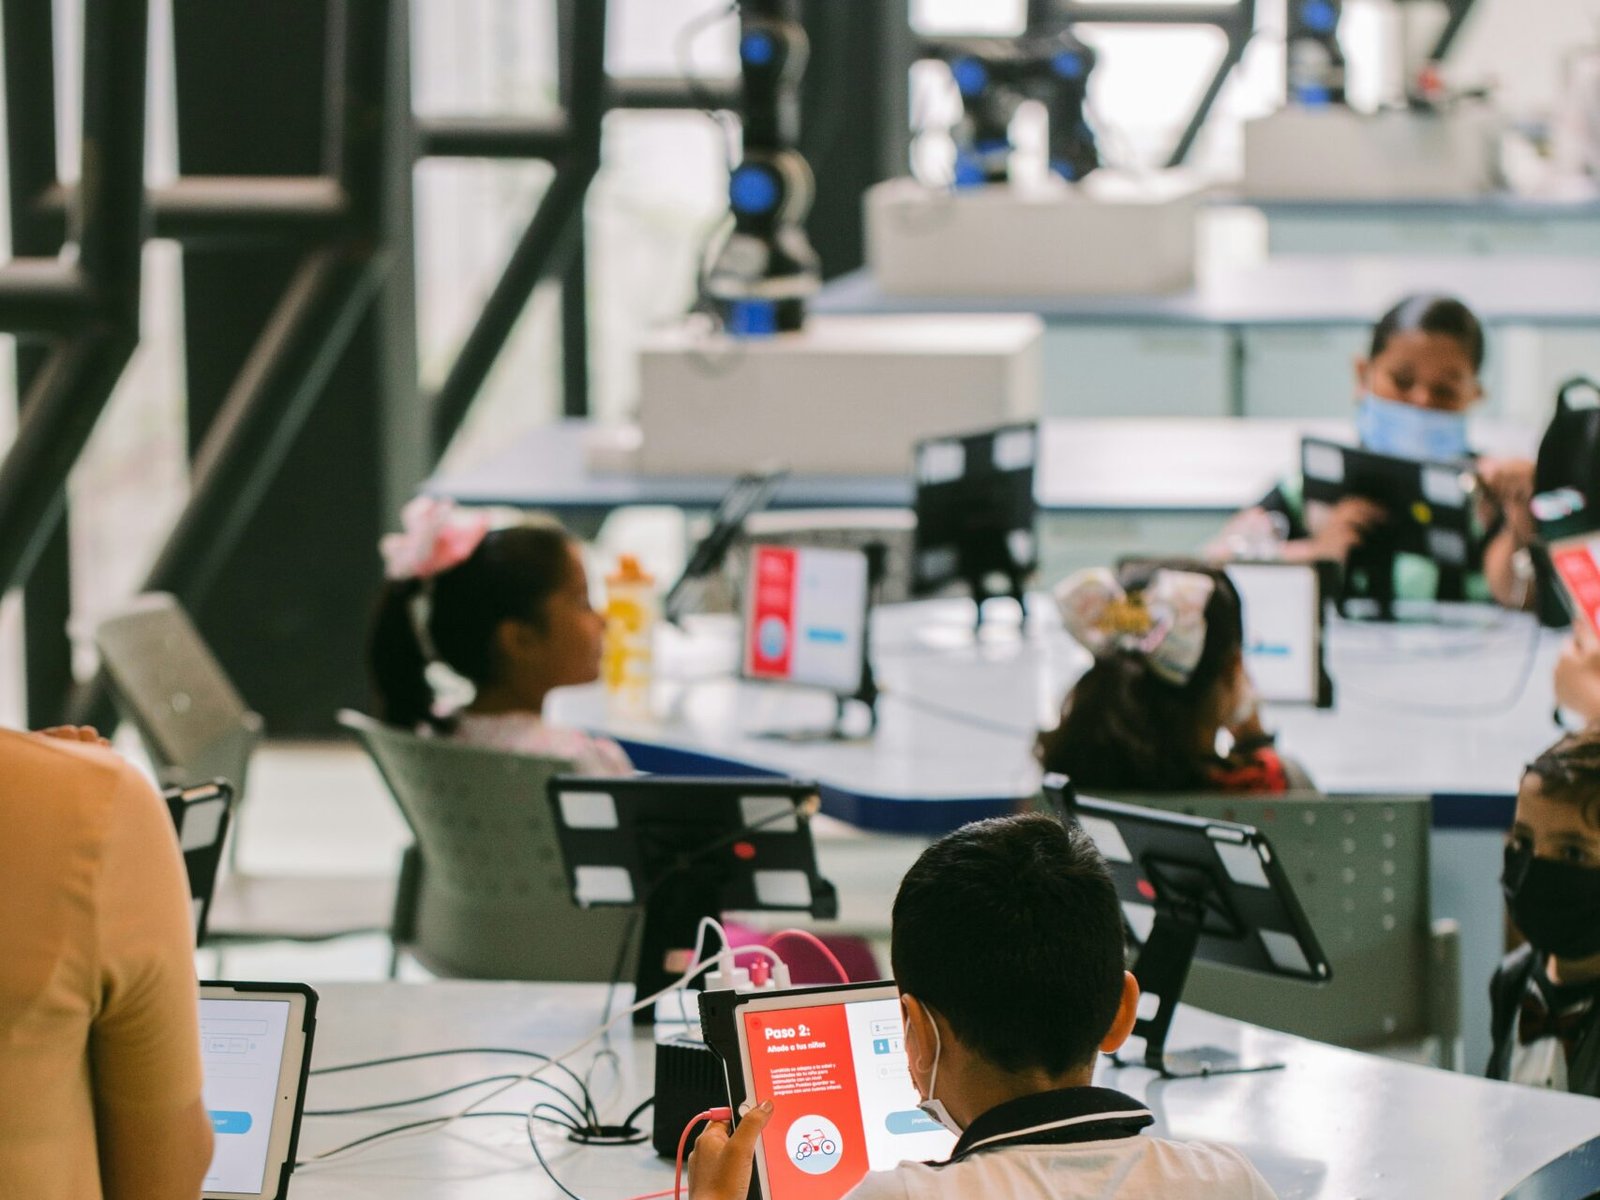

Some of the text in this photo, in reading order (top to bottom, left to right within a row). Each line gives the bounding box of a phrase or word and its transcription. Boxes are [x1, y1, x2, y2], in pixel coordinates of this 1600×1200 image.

[765, 1024, 811, 1040] Paso 2:
[807, 1041, 826, 1049] niños
